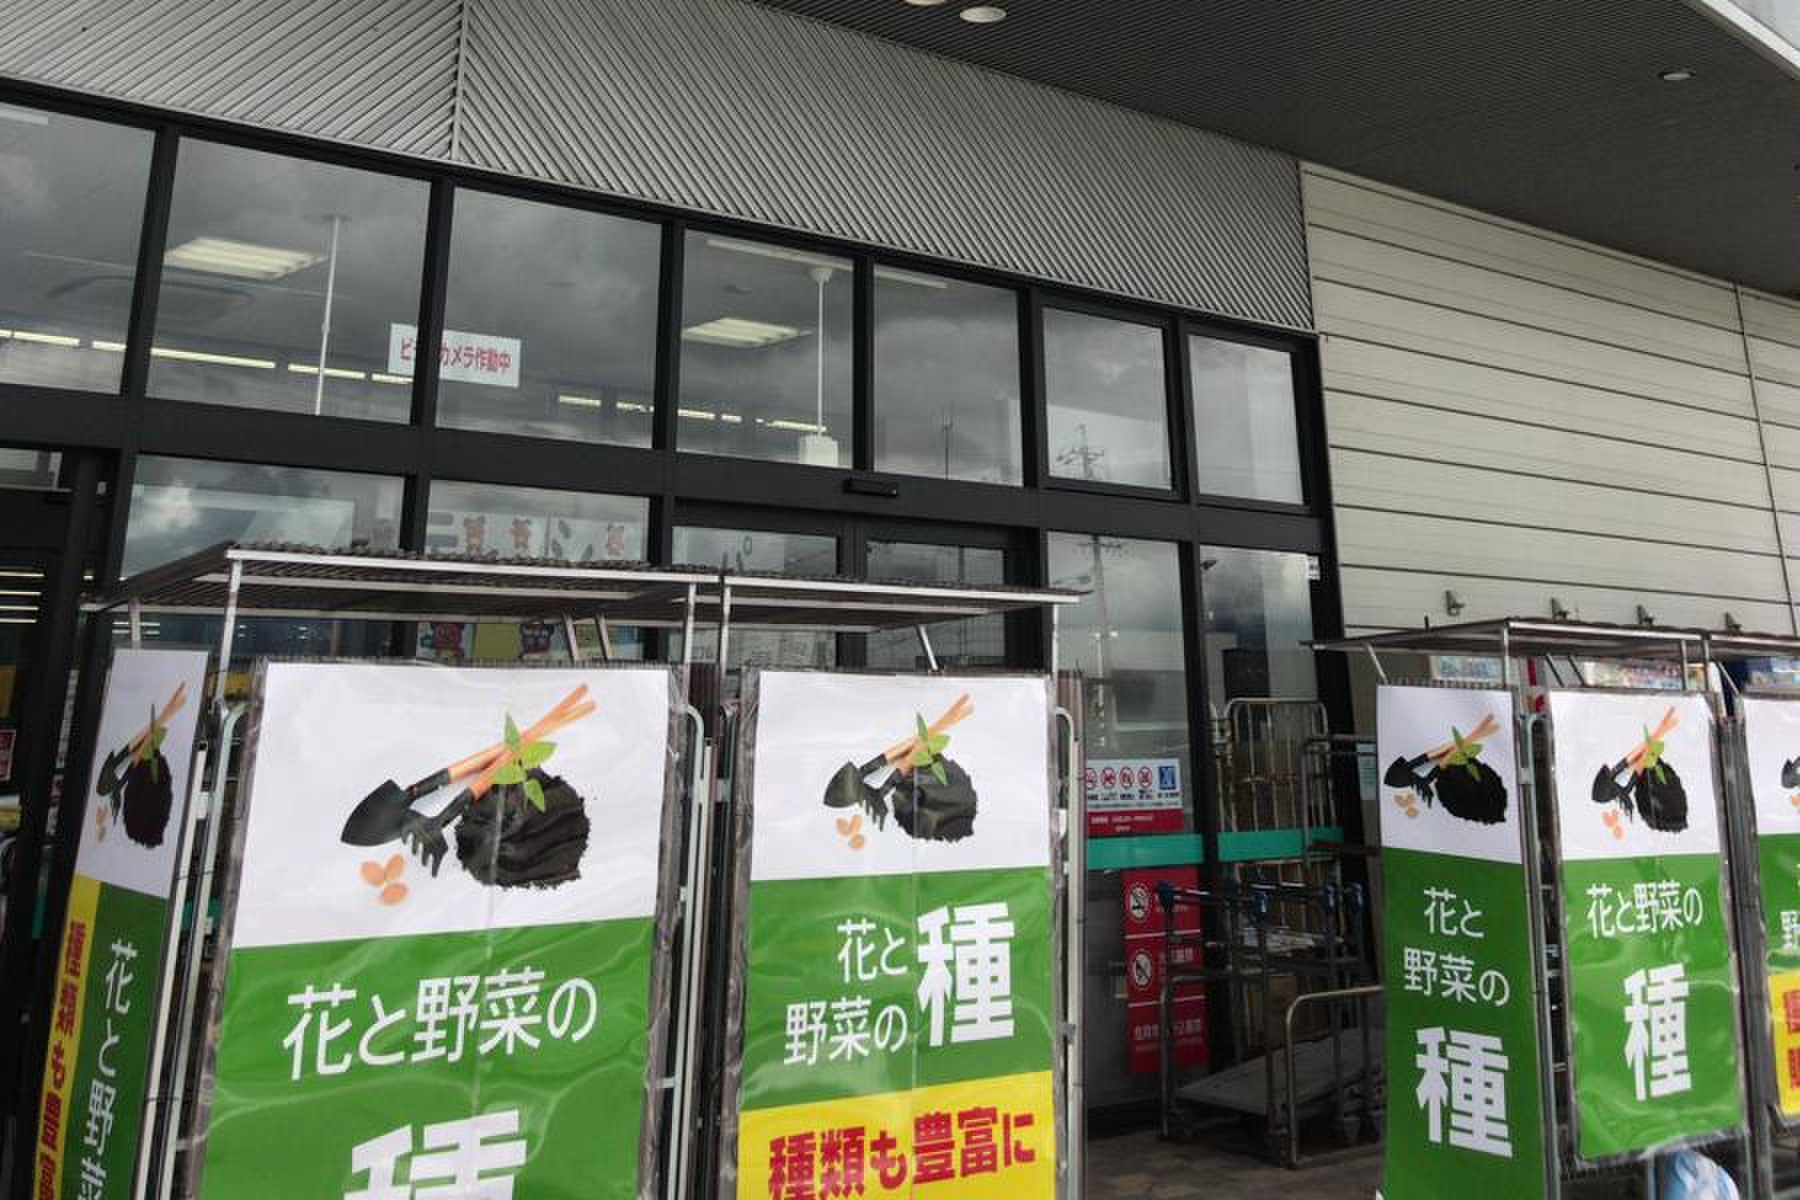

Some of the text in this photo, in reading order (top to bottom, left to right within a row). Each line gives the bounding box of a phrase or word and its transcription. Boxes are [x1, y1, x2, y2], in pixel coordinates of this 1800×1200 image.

[1422, 886, 1485, 938] 花と
[1585, 879, 1704, 938] 花と野菜の
[836, 918, 908, 983] 花と
[916, 901, 1015, 1046] 種
[1402, 946, 1510, 1007] 野菜の
[283, 966, 597, 1080] 花と野菜の
[783, 996, 908, 1066] 野菜の
[1623, 962, 1692, 1101] 種
[1414, 1026, 1513, 1158] 種
[768, 1106, 1036, 1200] 種類も豊富に
